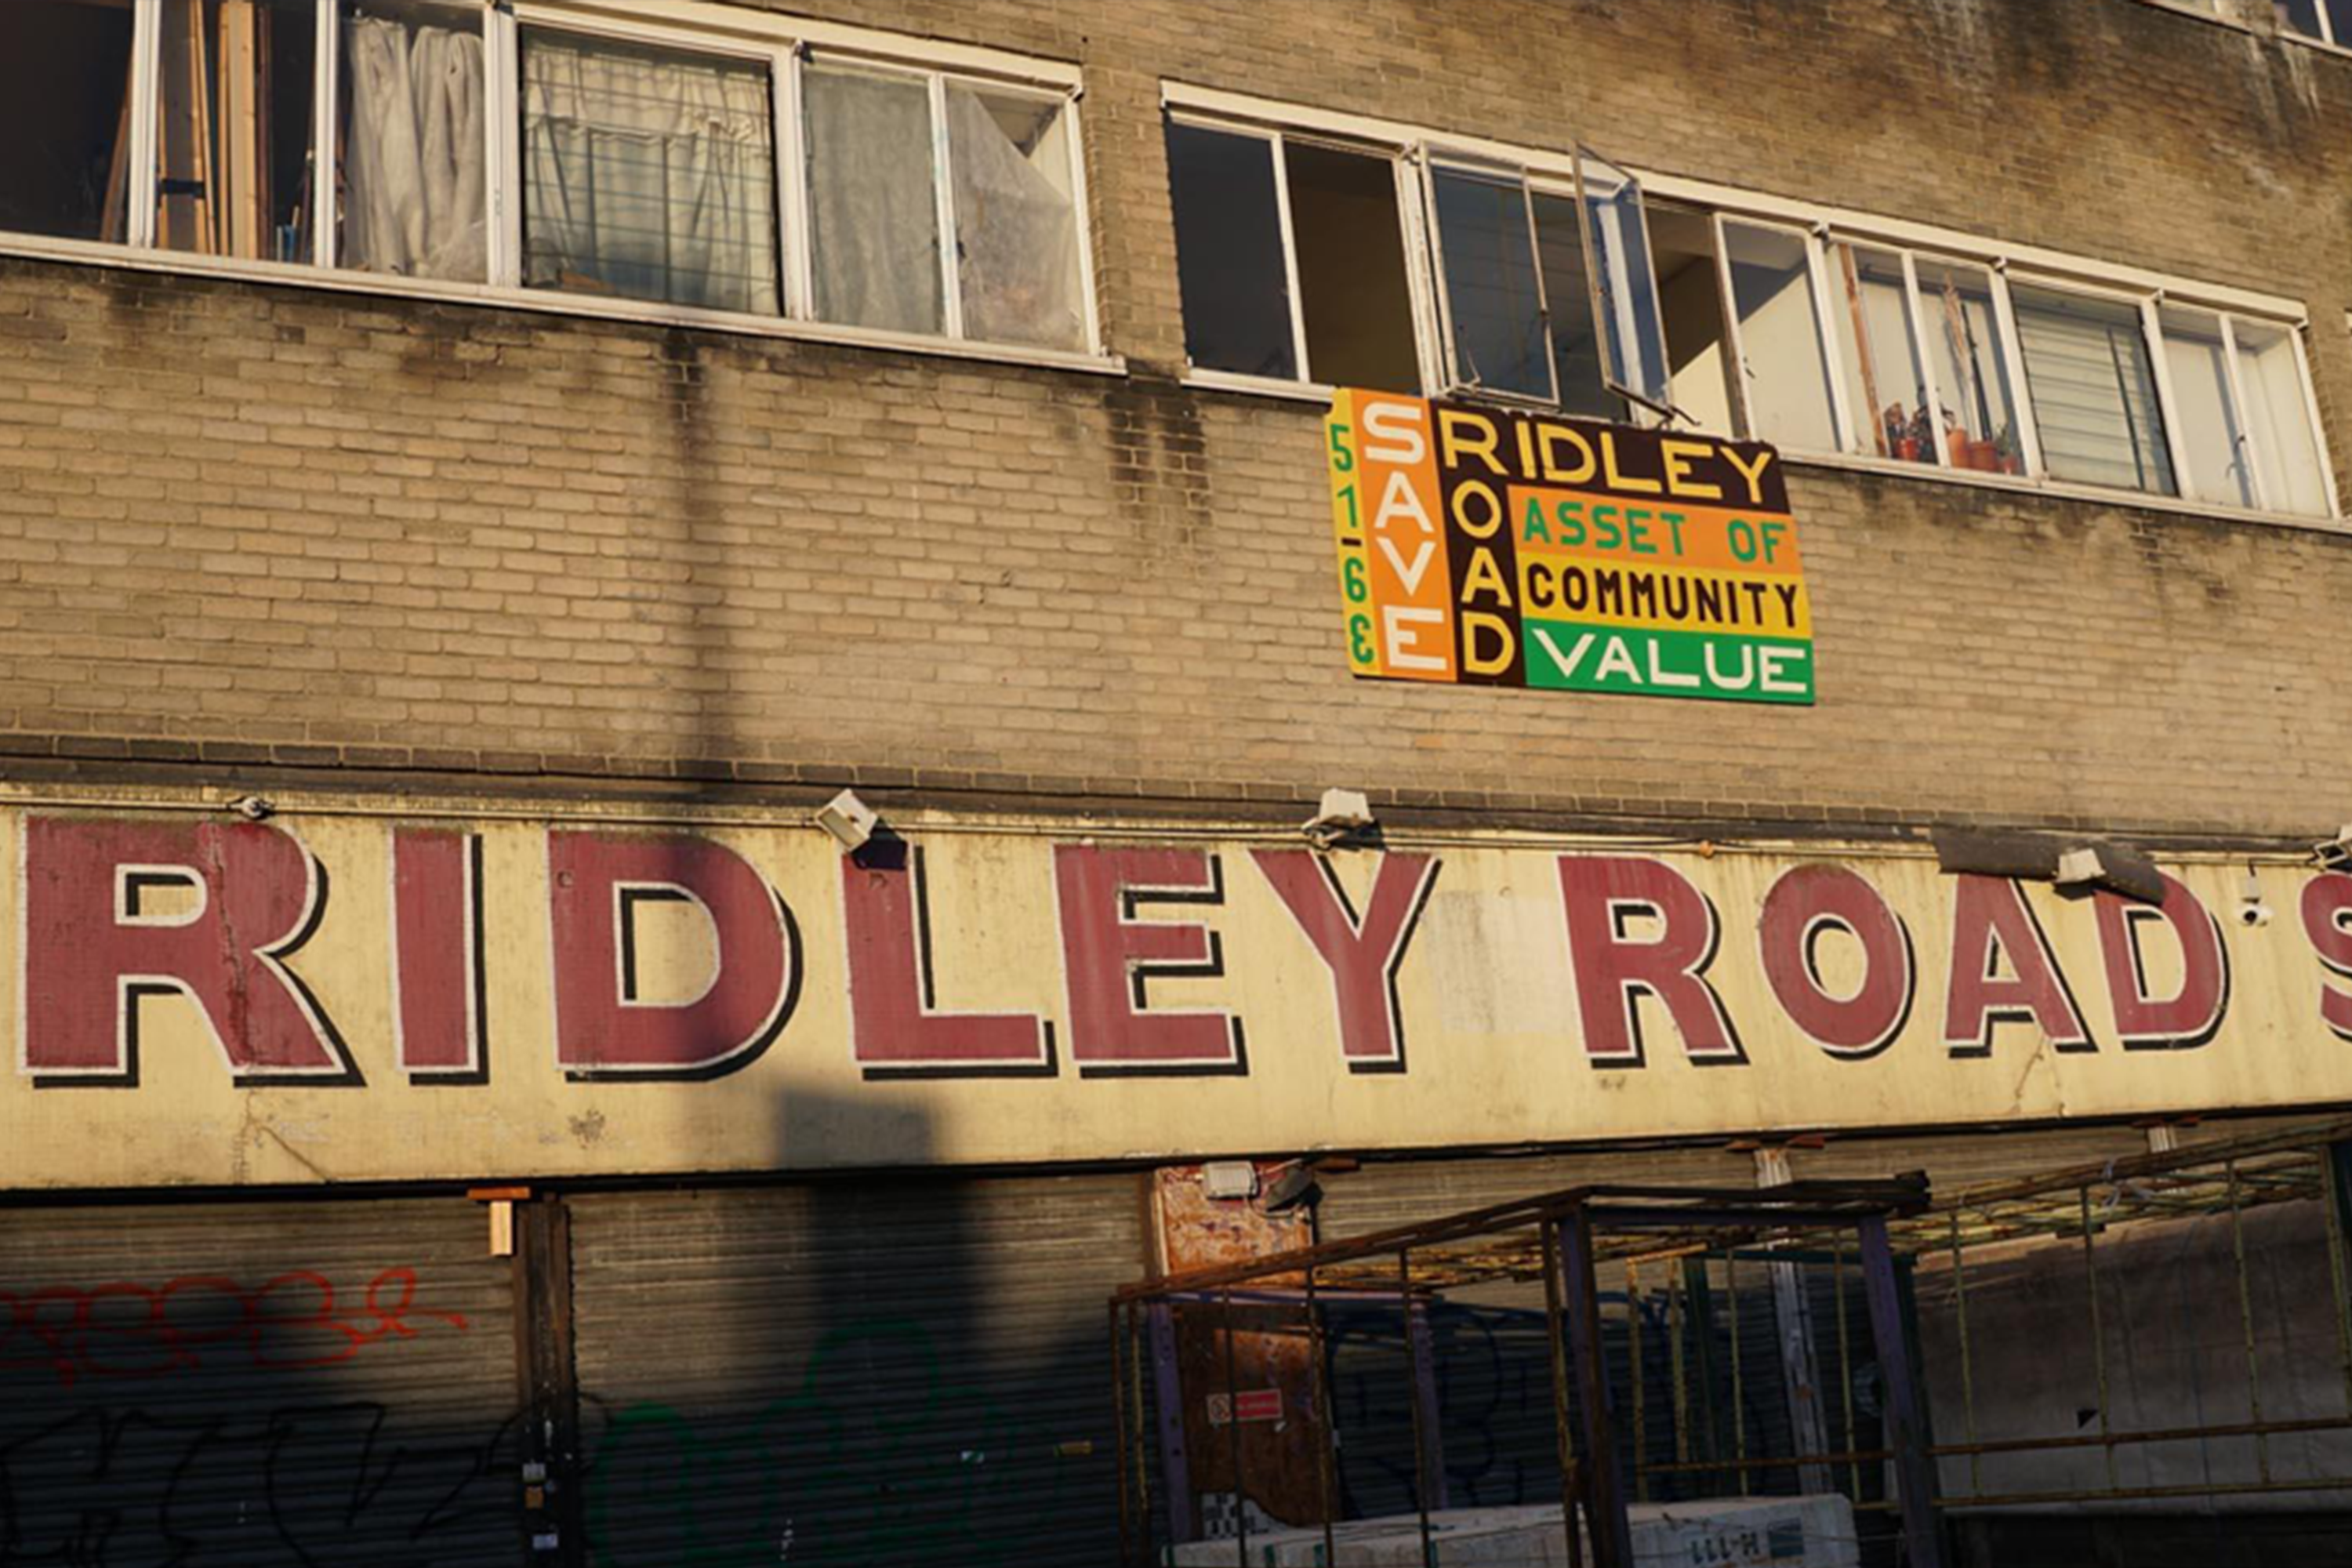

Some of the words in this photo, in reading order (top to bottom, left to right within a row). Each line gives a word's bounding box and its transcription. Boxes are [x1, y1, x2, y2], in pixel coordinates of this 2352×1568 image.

[1438, 408, 1773, 504] RIDLEY
[1363, 401, 1447, 672] SAVE
[1523, 497, 1686, 556] ASSET
[1726, 520, 1788, 564] OF
[1527, 562, 1798, 628] COMMUNITY
[1532, 628, 1808, 693] VALUE
[17, 812, 1443, 1088] RIDLEY
[1555, 853, 2231, 1069] ROAD
